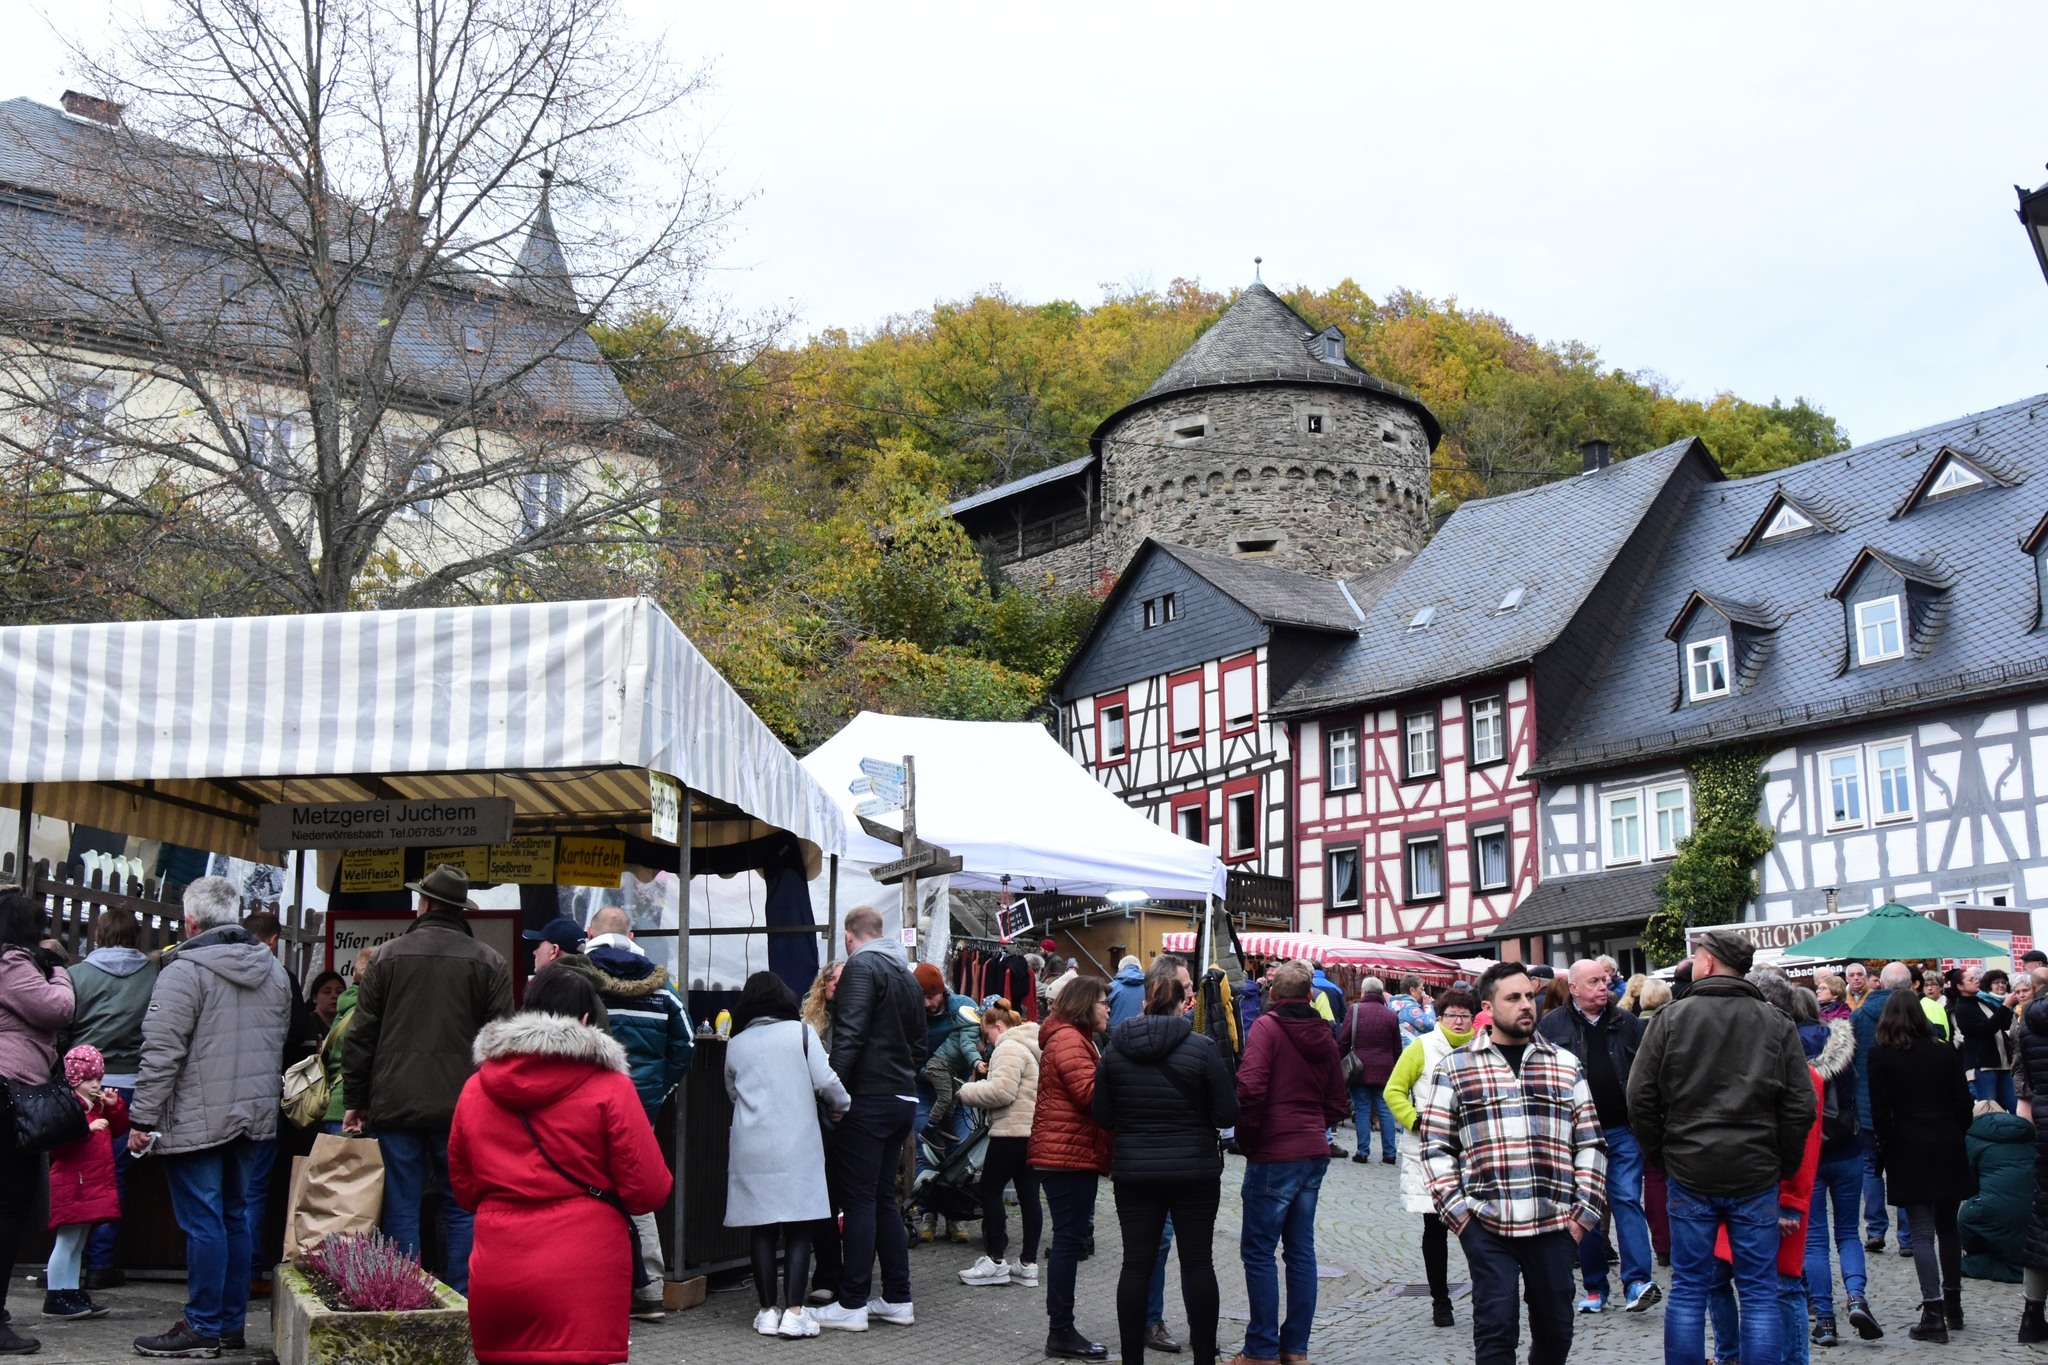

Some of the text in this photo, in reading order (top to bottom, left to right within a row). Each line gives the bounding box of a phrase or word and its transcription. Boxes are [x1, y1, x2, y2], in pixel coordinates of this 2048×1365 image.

[293, 803, 476, 828] Metzgerei Juchem
[292, 826, 477, 841] Niederwörresbach Tel.06785/7128
[512, 837, 552, 849] Spießbraten
[343, 847, 399, 858] Kartoffelwurst
[427, 849, 464, 860] Bratwurst
[560, 844, 621, 868] Kartoffeln
[344, 866, 400, 881] Wellfleisch
[490, 861, 532, 876] Spießbraten
[334, 931, 370, 949] Hier
